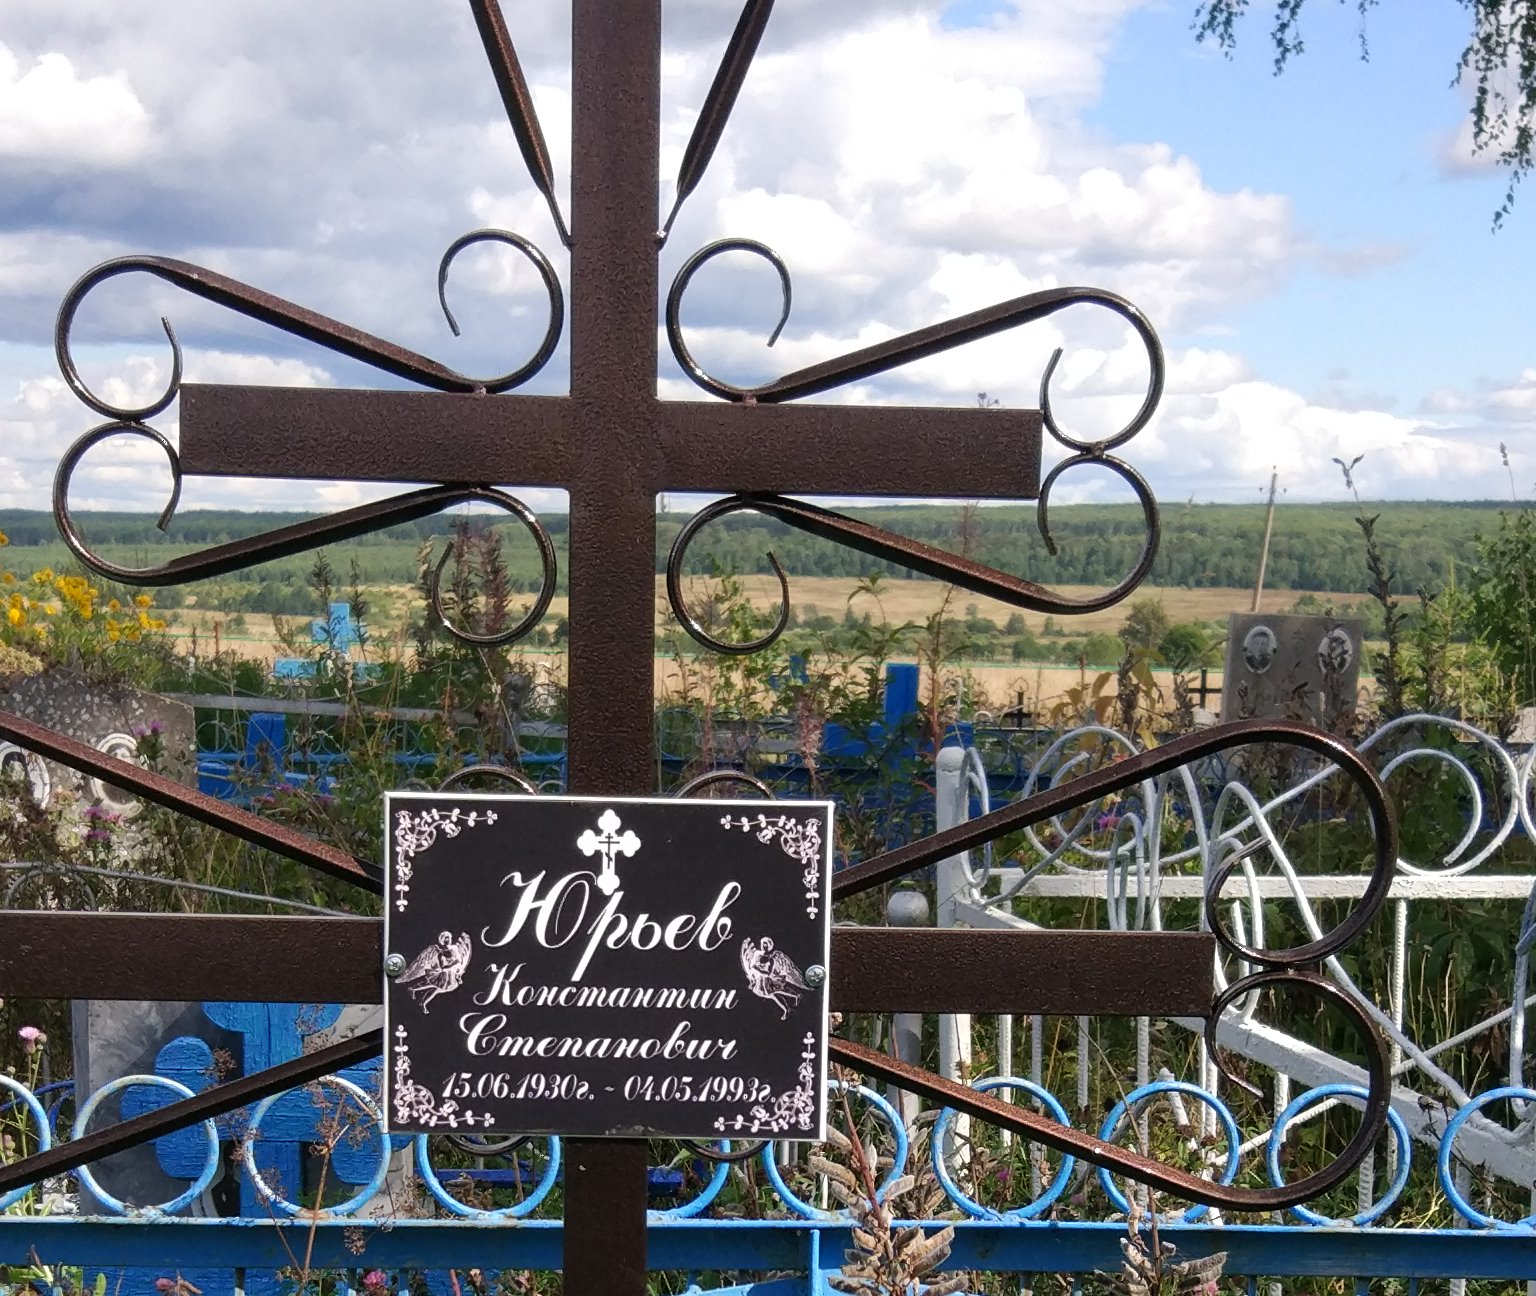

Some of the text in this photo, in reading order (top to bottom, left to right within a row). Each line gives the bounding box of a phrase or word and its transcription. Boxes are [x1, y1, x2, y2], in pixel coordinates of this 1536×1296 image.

[480, 870, 742, 982] Юрьев
[472, 963, 738, 1010] Константин
[459, 1012, 738, 1060] Степанович
[441, 1072, 595, 1100] 15.06.1930г.
[624, 1075, 776, 1104] 04.05.1993г.
